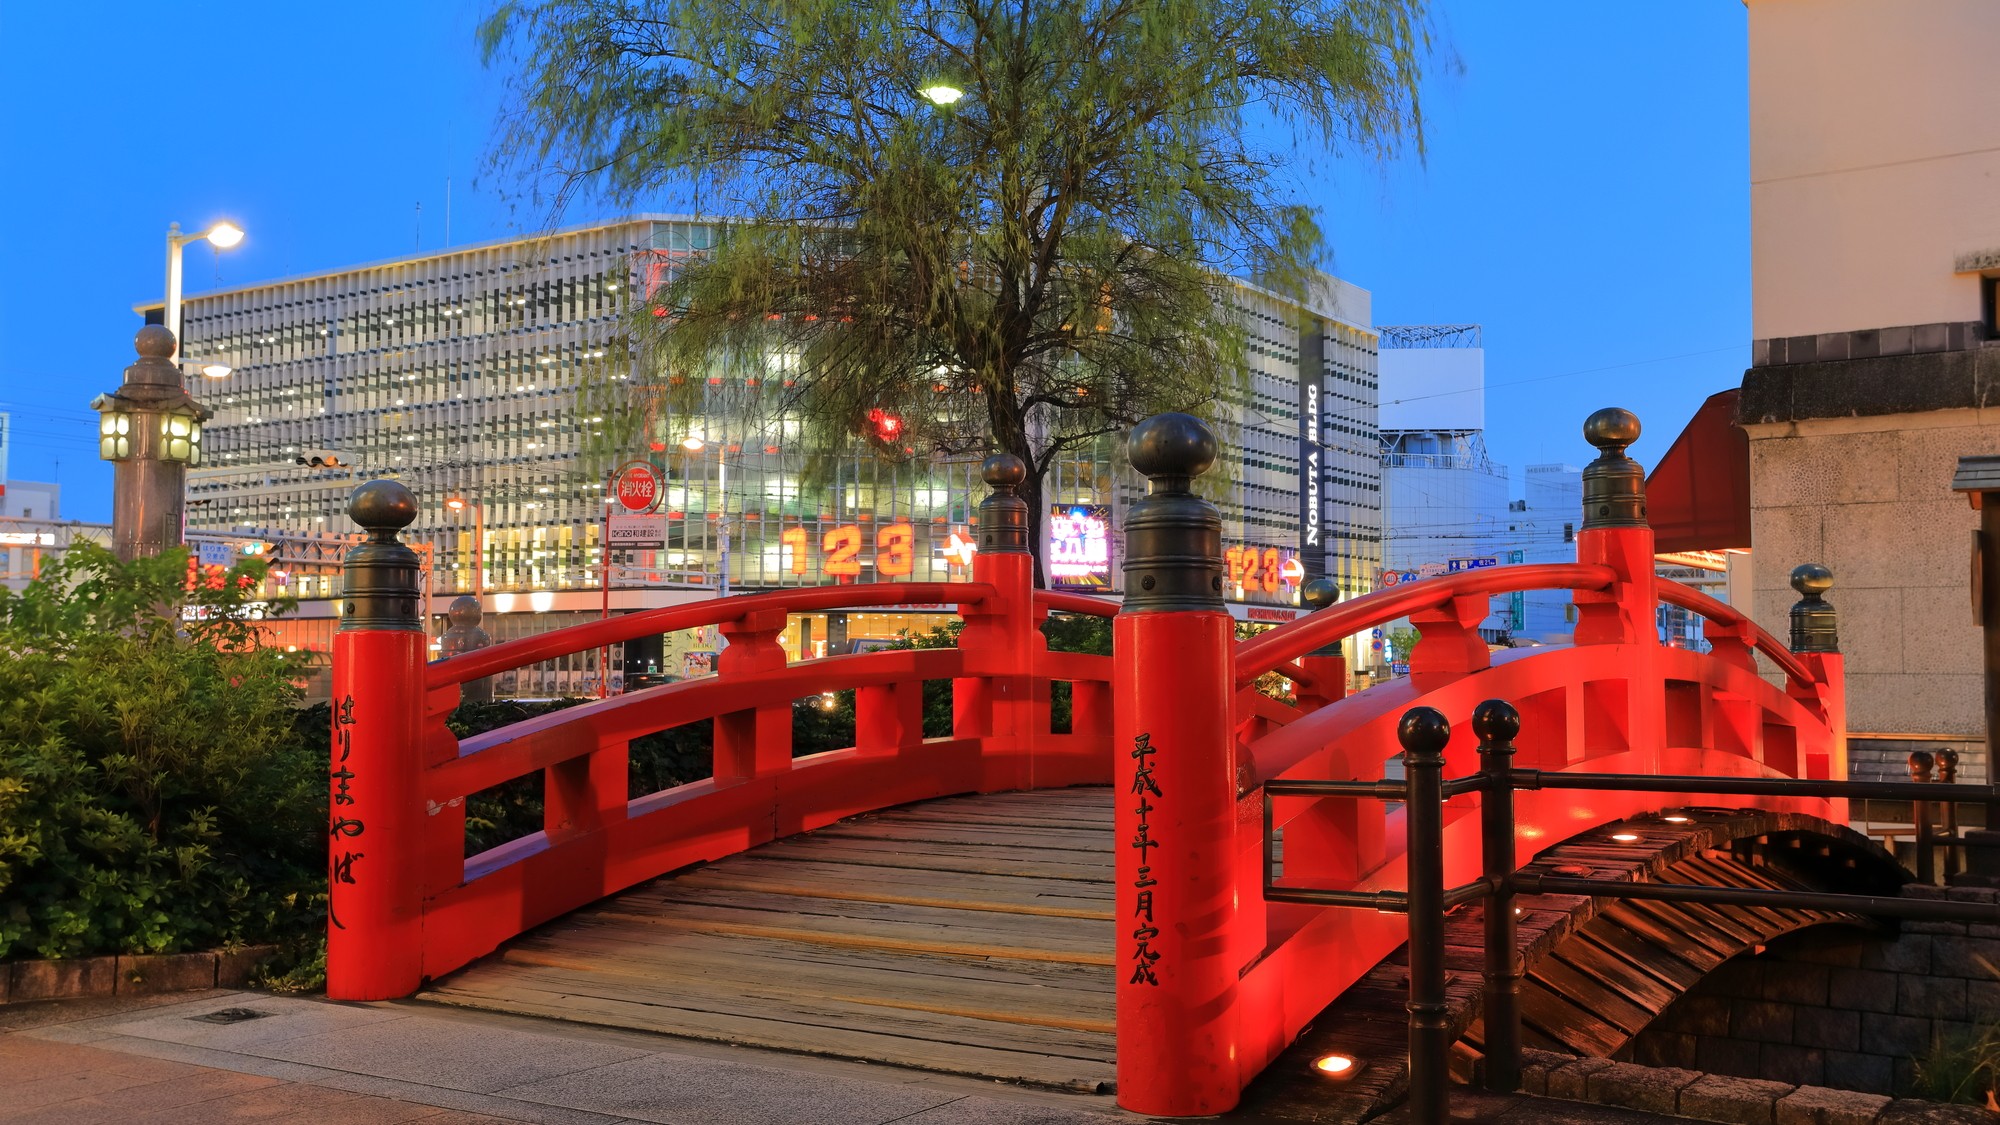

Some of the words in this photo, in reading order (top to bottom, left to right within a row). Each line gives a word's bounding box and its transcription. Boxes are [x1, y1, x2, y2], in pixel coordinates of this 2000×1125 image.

[1308, 384, 1318, 443] BLDG
[621, 480, 653, 497] 消火栓
[1307, 452, 1318, 547] NOBUTA
[1225, 547, 1279, 592] 123
[1387, 574, 1396, 584] 40
[329, 694, 365, 930] はりまやばし
[1130, 732, 1163, 987] 平成十年三月完成
